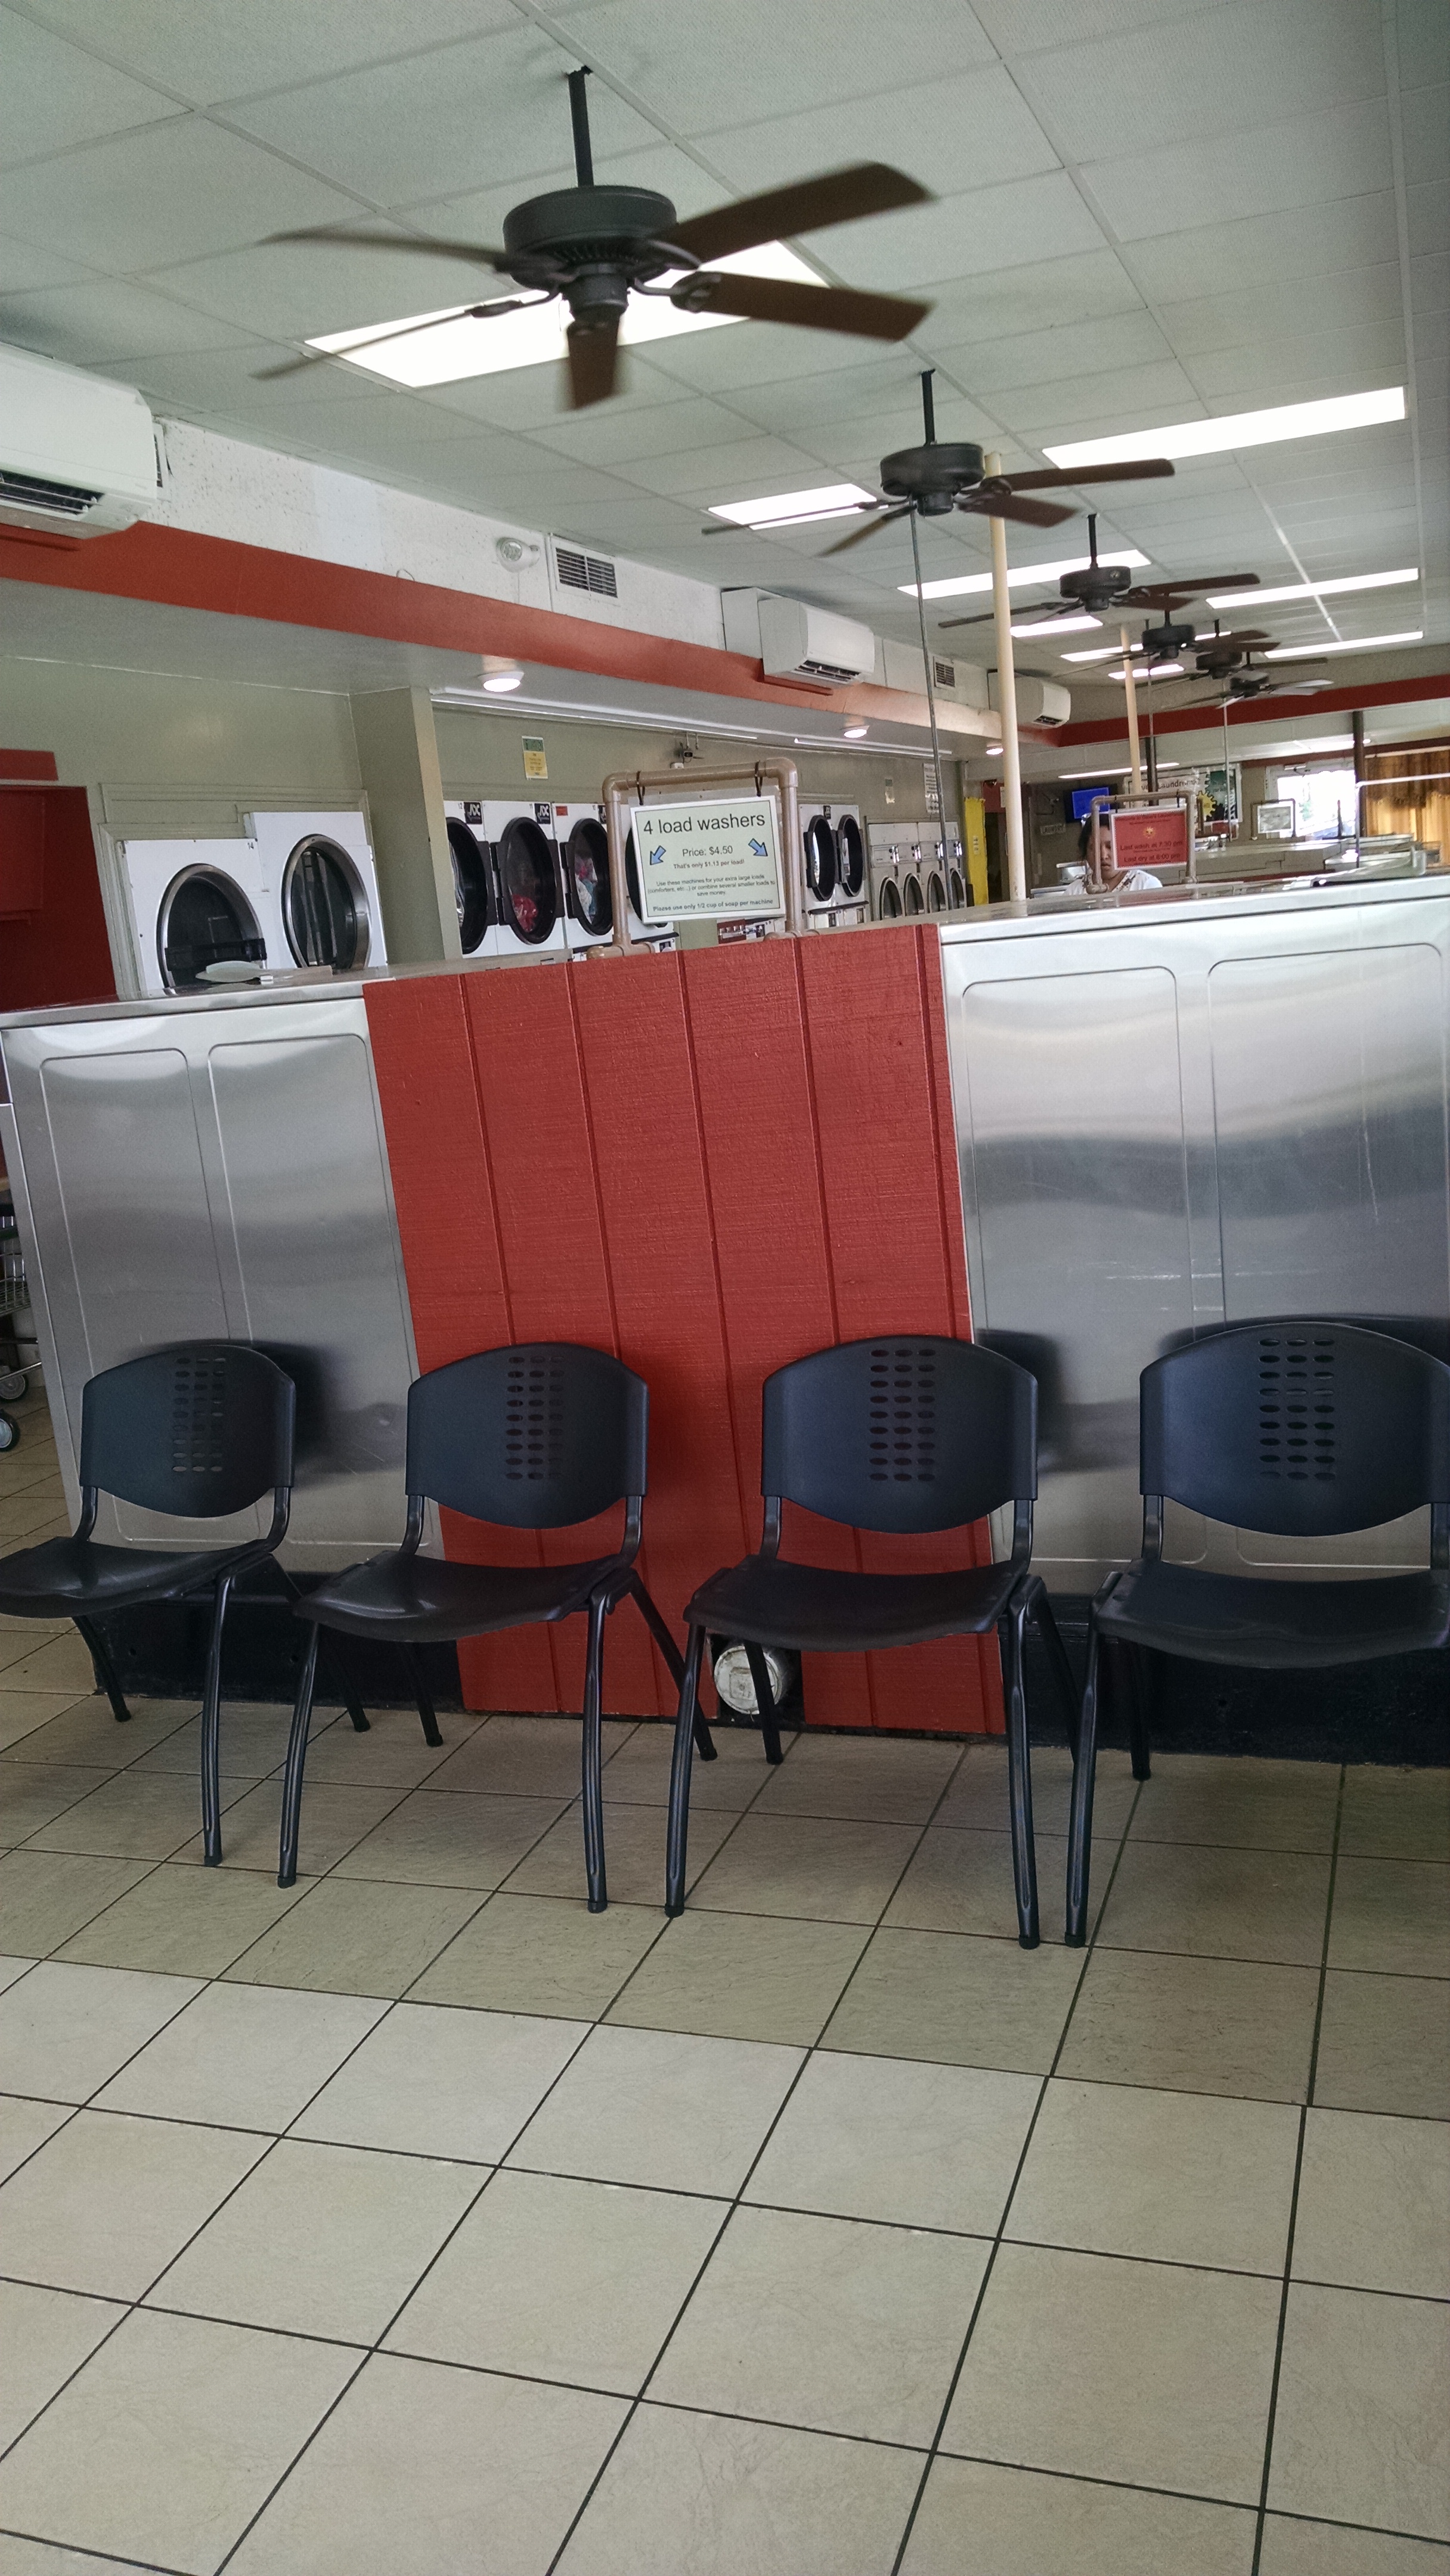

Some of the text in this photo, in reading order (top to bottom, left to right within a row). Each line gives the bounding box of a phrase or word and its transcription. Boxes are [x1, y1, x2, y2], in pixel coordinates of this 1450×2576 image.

[643, 813, 766, 835] 4 load washers
[683, 846, 733, 857] Price: $4.50
